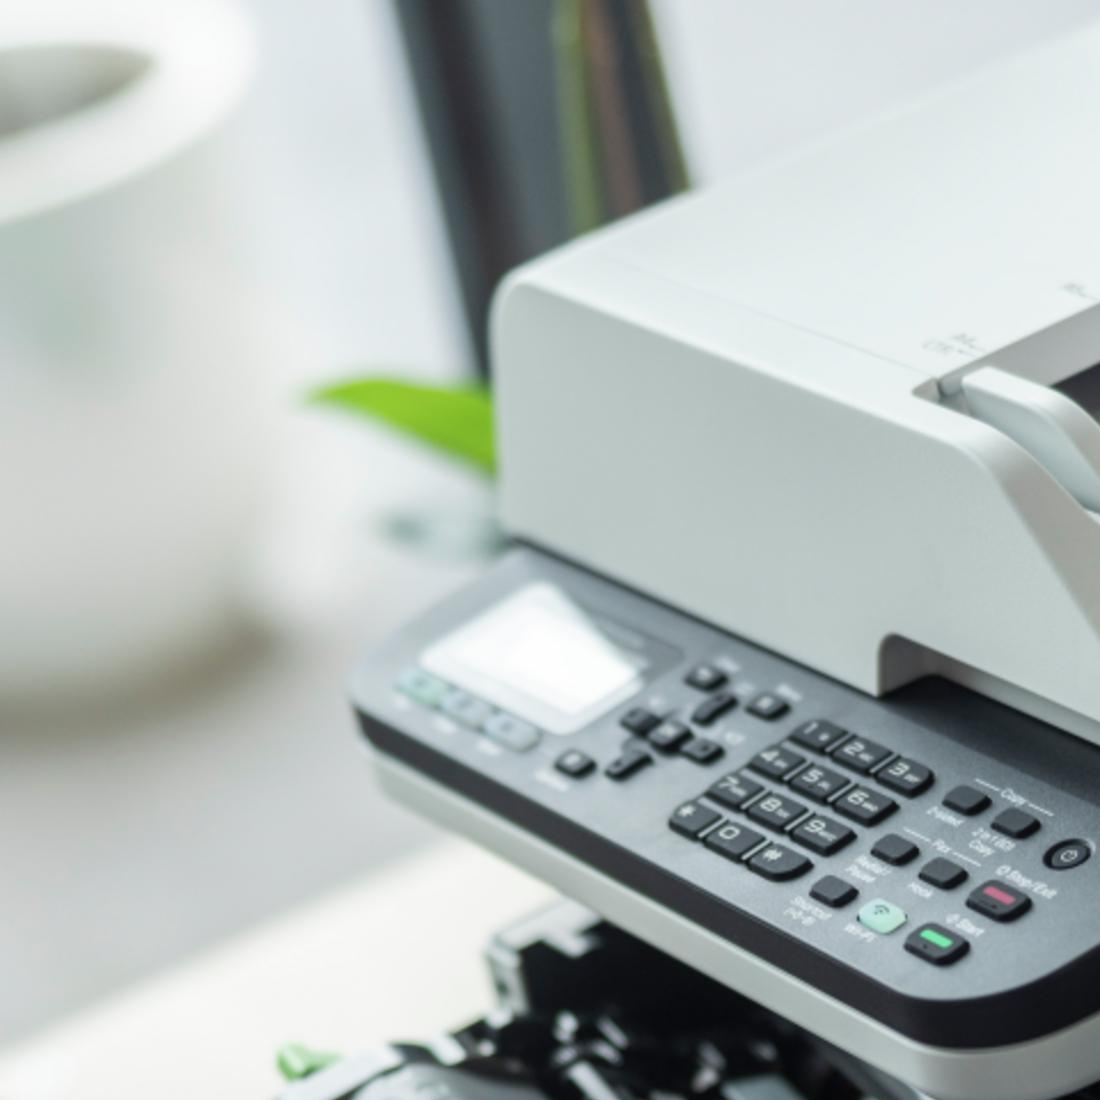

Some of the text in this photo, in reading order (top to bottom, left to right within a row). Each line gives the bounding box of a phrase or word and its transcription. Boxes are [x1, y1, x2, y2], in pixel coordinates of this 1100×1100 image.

[803, 721, 819, 735] 1
[844, 741, 865, 756] 2
[759, 751, 780, 762] 4
[801, 768, 823, 783] 5
[888, 761, 907, 777] 3
[718, 775, 739, 790] 7
[847, 790, 869, 805] 6
[759, 798, 782, 812] 8
[718, 826, 740, 840] 0
[804, 819, 826, 833] 9
